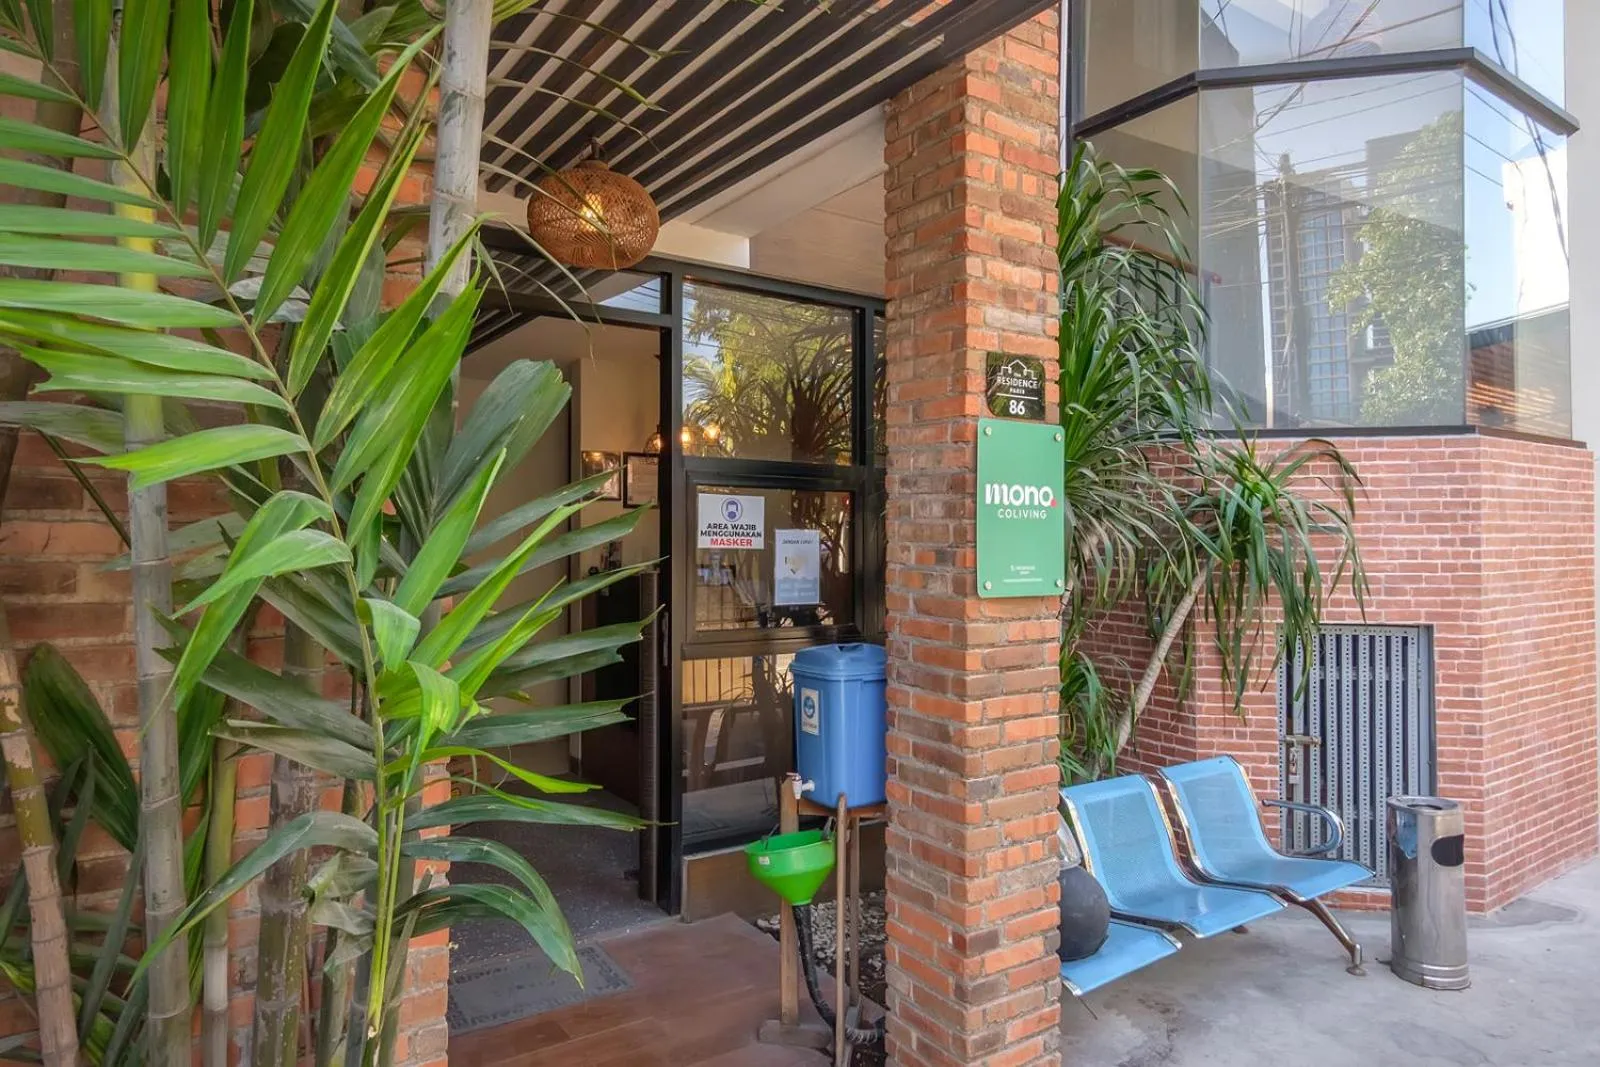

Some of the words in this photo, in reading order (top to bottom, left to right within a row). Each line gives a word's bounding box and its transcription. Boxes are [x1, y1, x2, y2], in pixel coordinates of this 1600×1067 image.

[997, 376, 1038, 389] RESIDENCE
[1009, 400, 1025, 415] 86
[998, 508, 1047, 520] COLIVING
[731, 523, 756, 531] WAJIB
[700, 530, 762, 538] MENGGUNAKAN
[710, 538, 753, 547] MASKER
